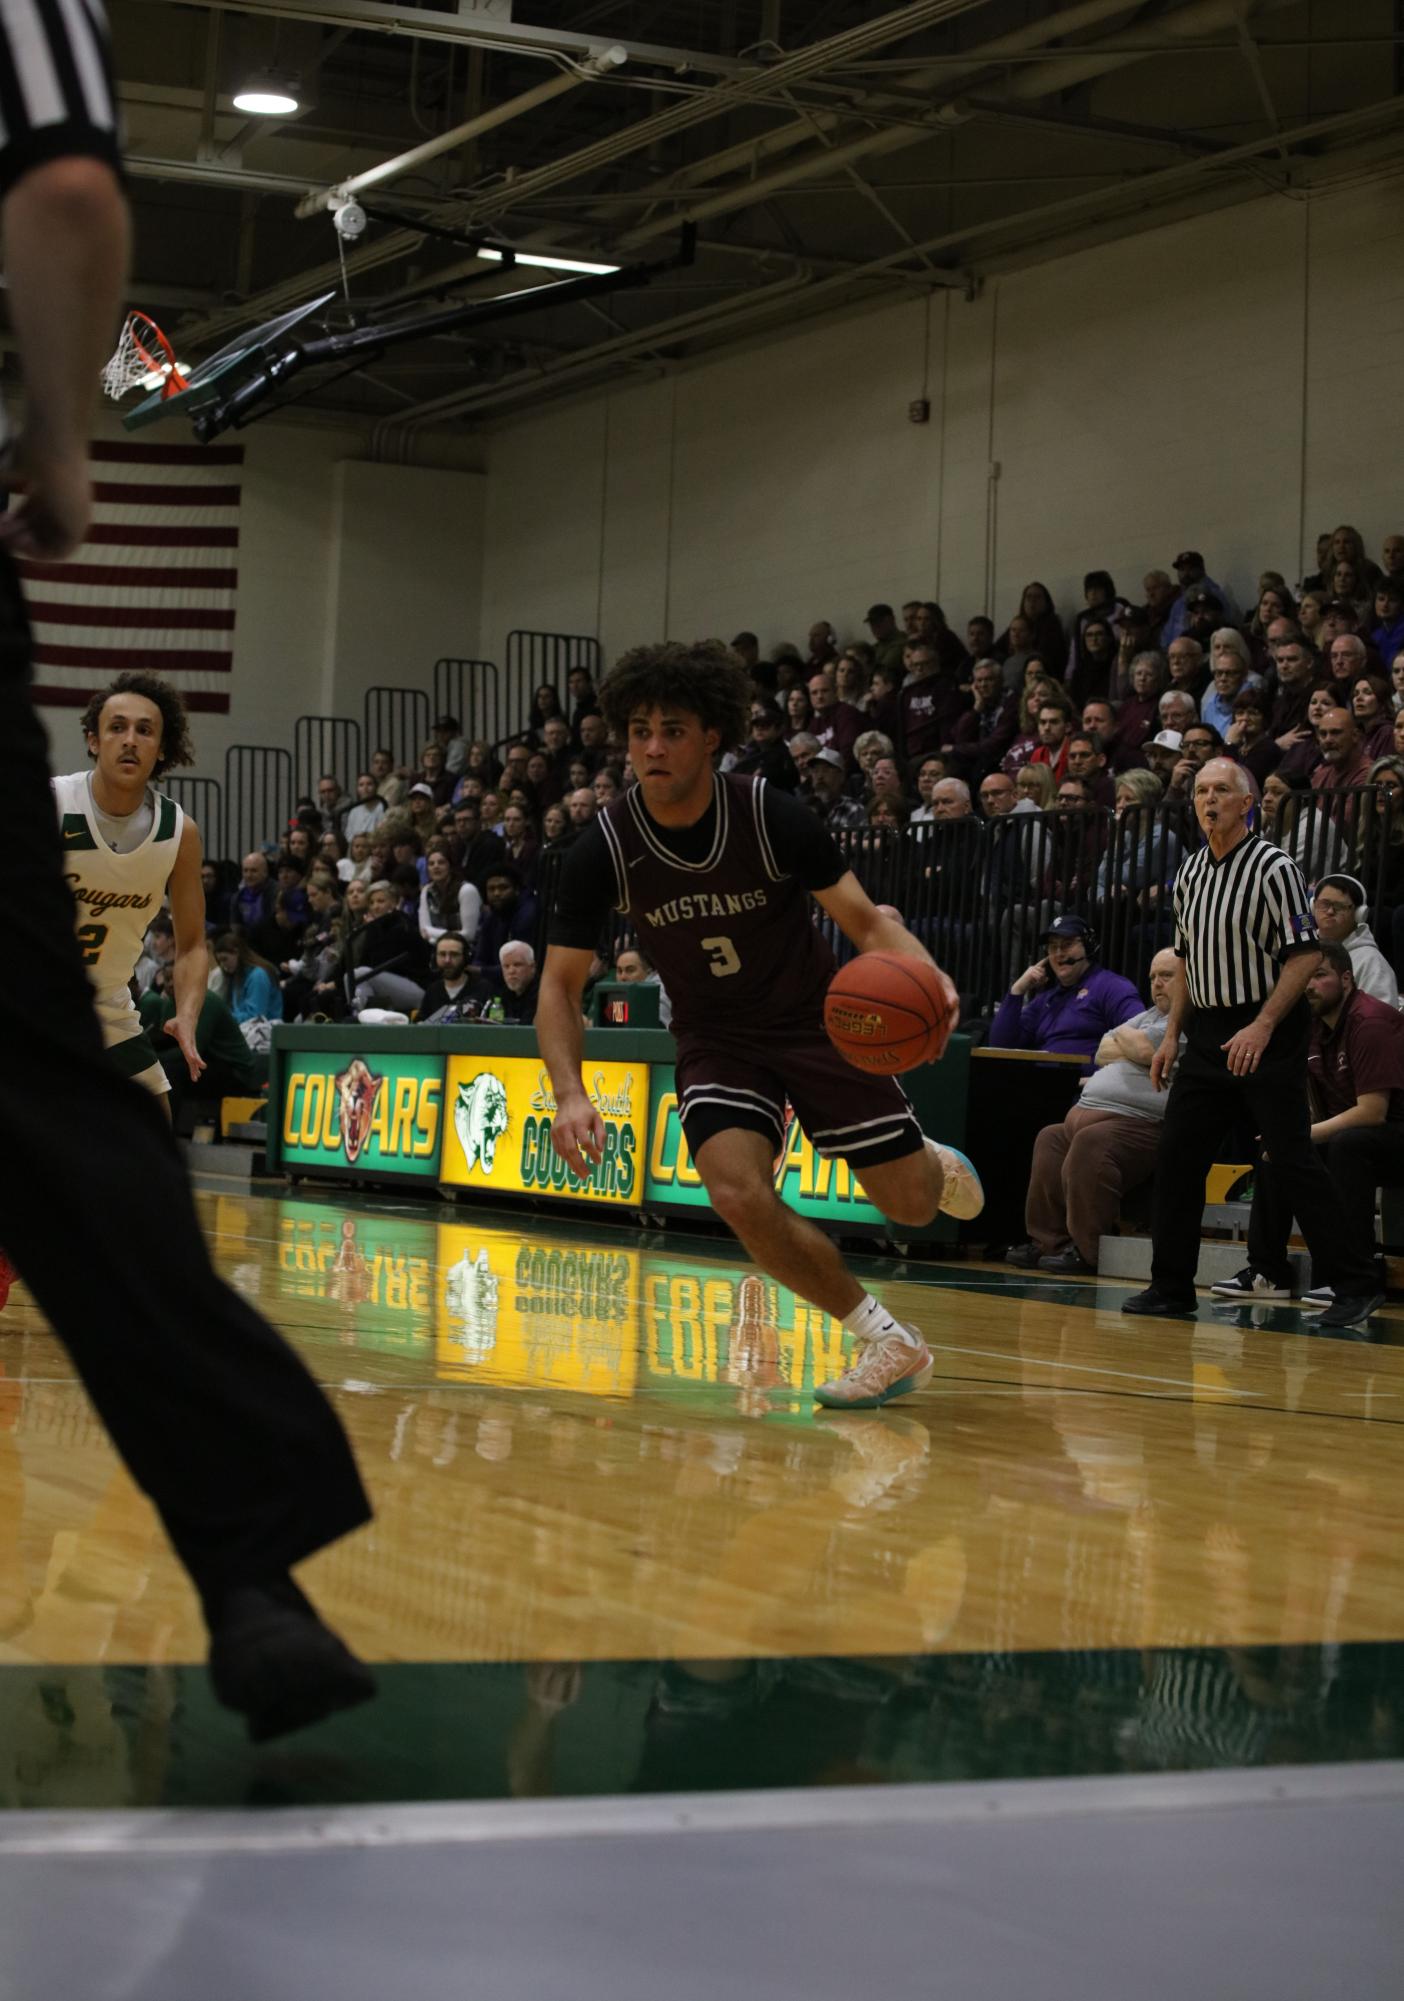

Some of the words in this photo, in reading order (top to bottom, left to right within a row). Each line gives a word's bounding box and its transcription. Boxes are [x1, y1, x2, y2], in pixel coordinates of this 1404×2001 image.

[645, 889, 767, 928] MUSTANGS
[701, 936, 742, 977] 3
[283, 1072, 442, 1159] COUARS
